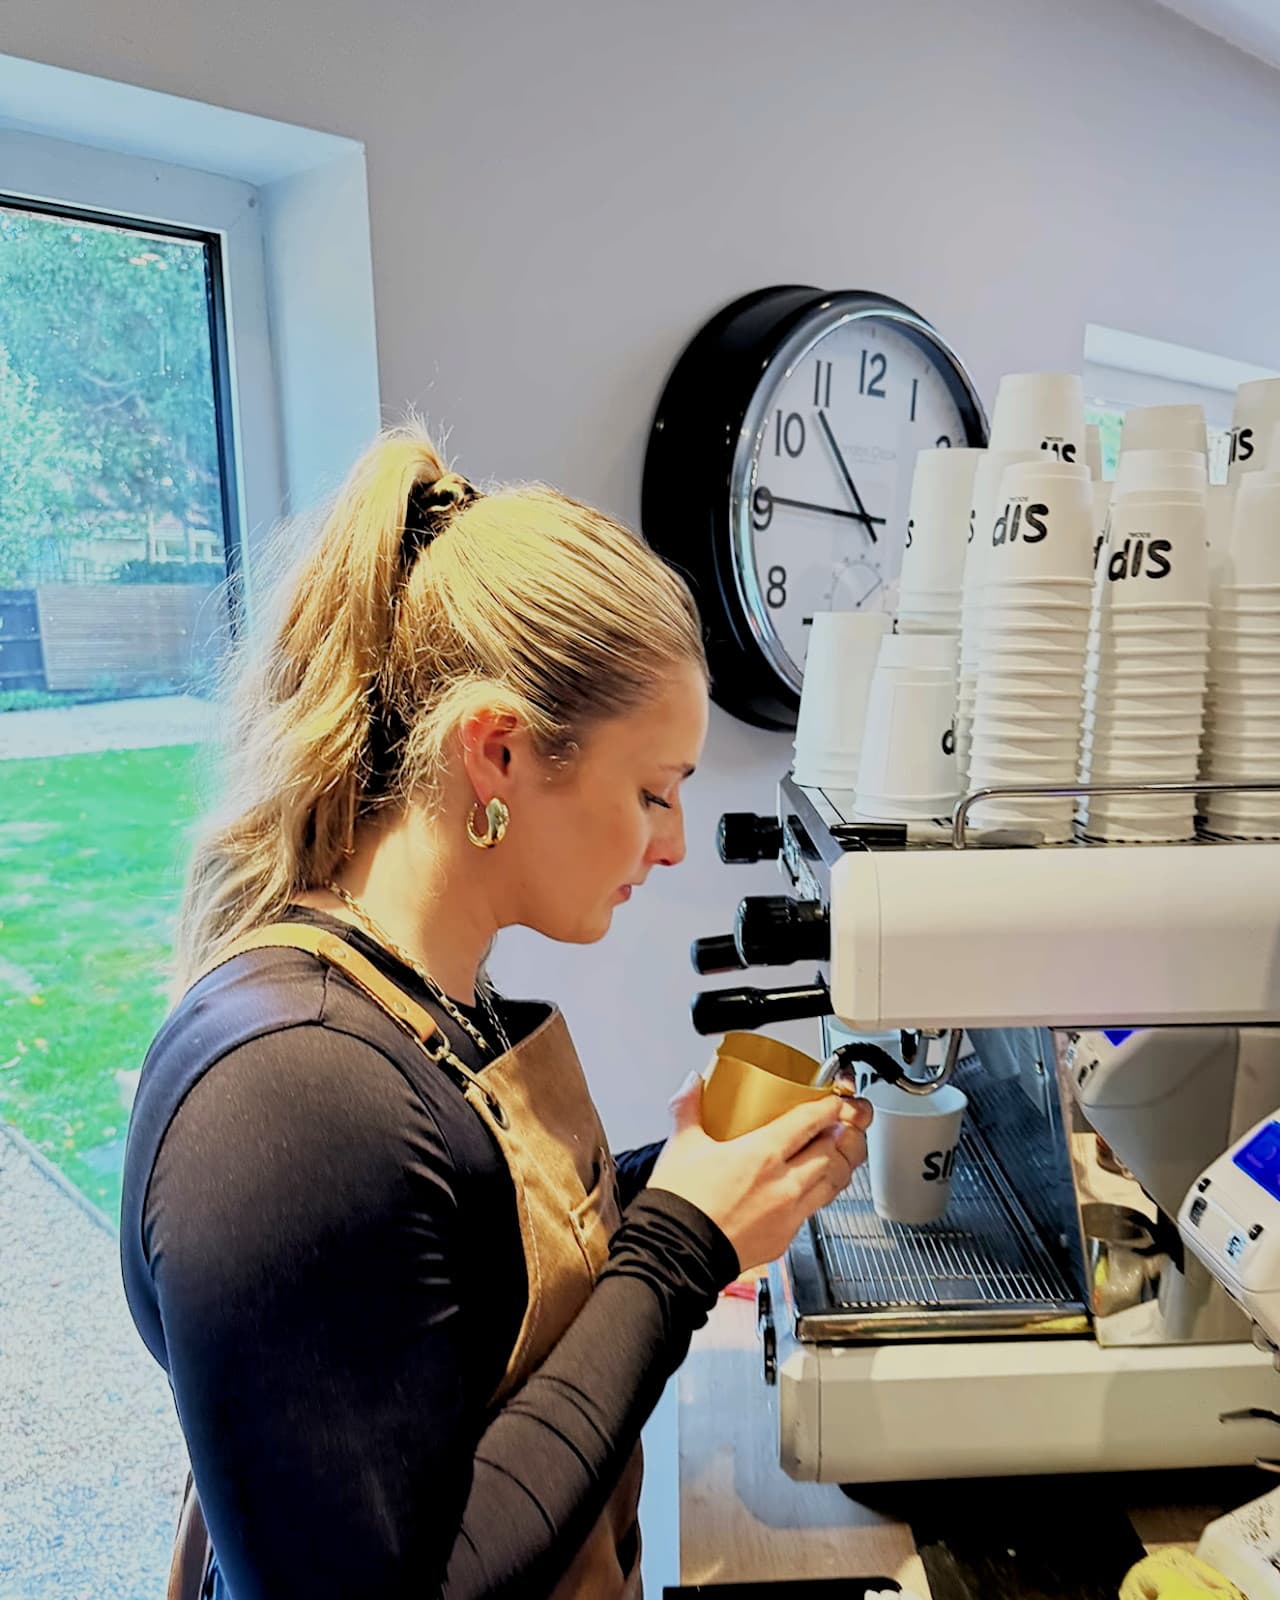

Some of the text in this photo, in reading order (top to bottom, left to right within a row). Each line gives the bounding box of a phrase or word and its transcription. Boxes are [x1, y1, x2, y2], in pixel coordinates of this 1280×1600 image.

[813, 360, 832, 408] 11
[858, 349, 887, 398] 12
[910, 378, 918, 422] 1
[774, 409, 806, 458] 10
[753, 486, 773, 531] 9
[766, 565, 787, 609] 8
